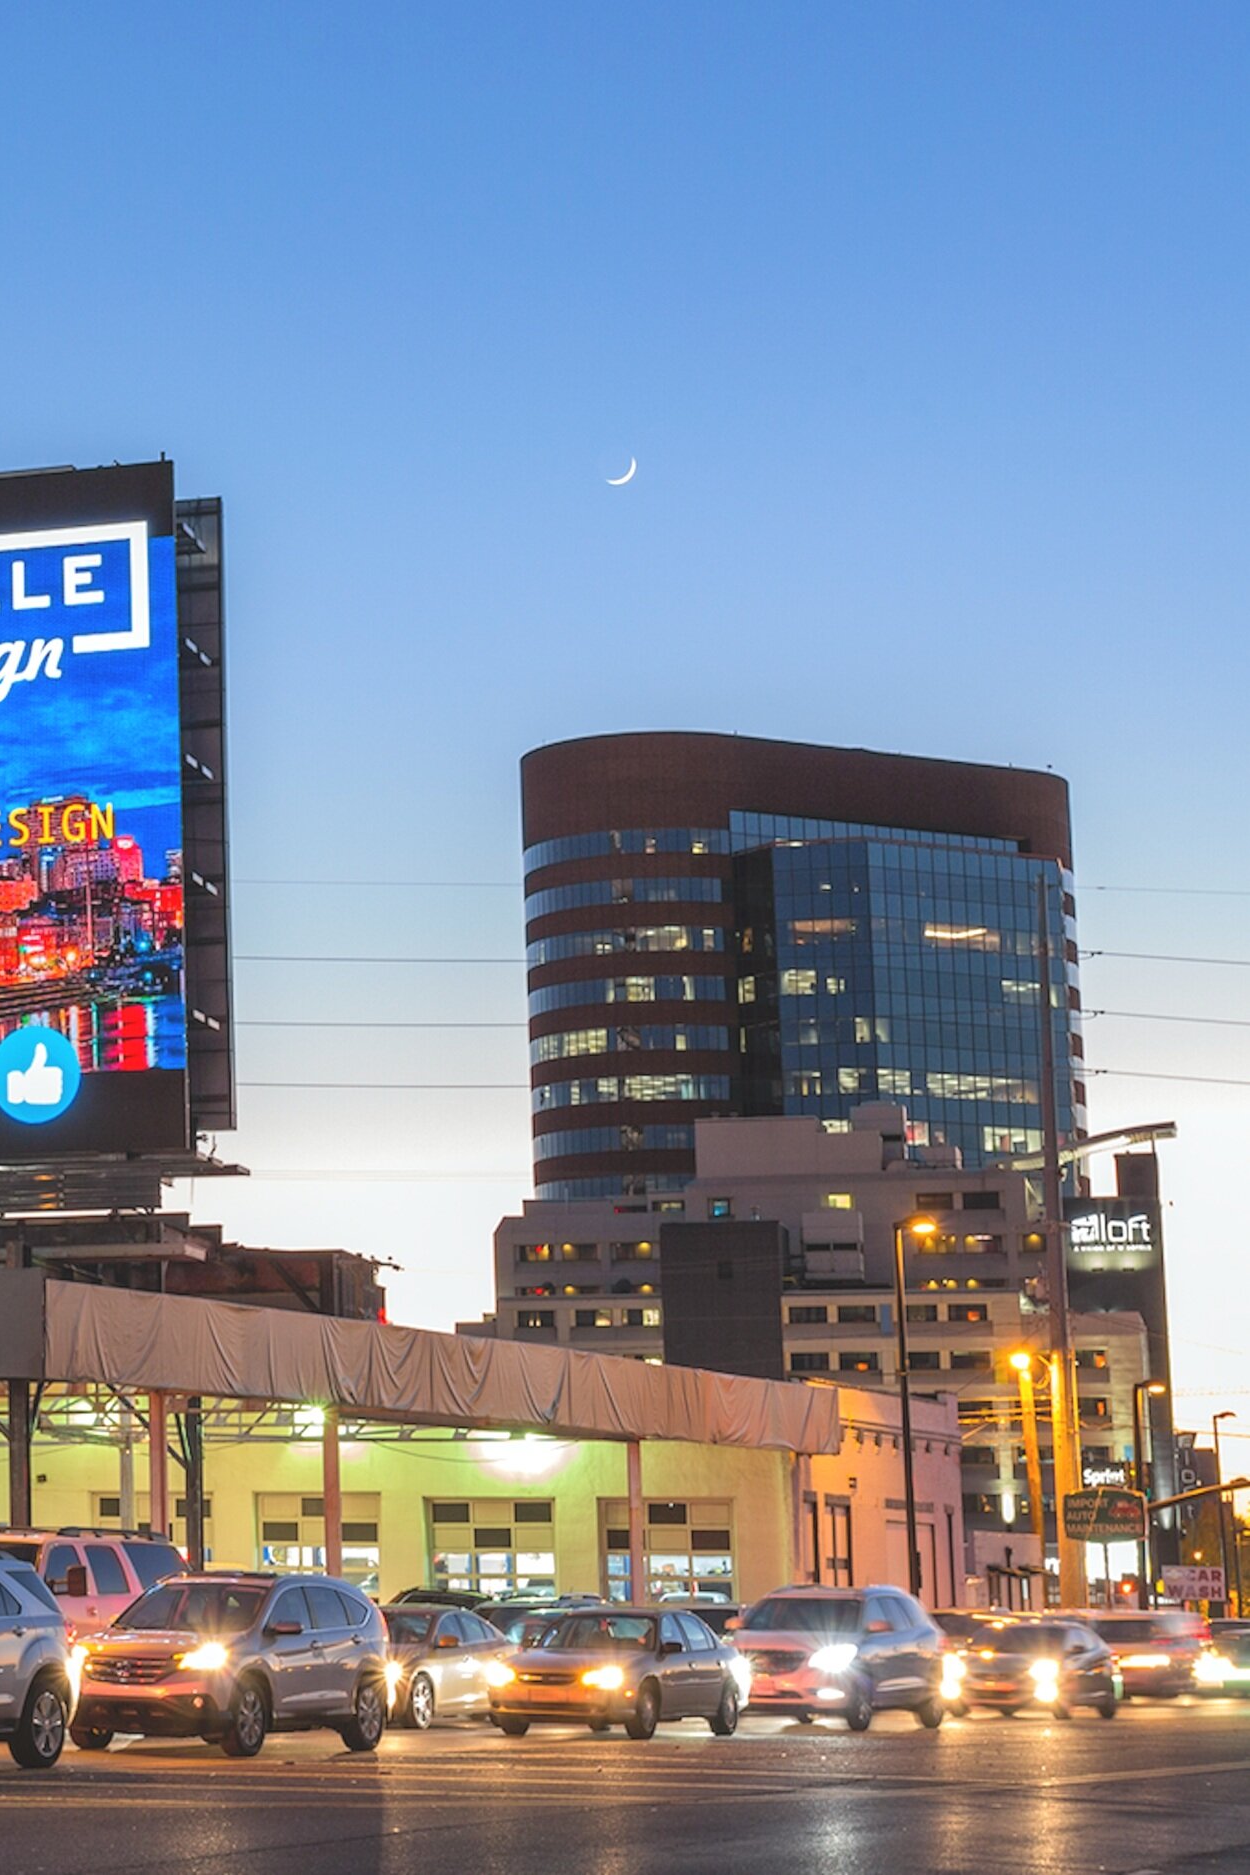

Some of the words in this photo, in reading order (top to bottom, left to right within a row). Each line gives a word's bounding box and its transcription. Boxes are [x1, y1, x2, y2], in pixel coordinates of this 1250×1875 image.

[1067, 1498, 1109, 1508] IMPORT
[1066, 1511, 1096, 1520] AUTO
[1066, 1523, 1143, 1533] MAINTENANCE
[1184, 1570, 1223, 1583] CAR
[1167, 1585, 1223, 1599] WASH
